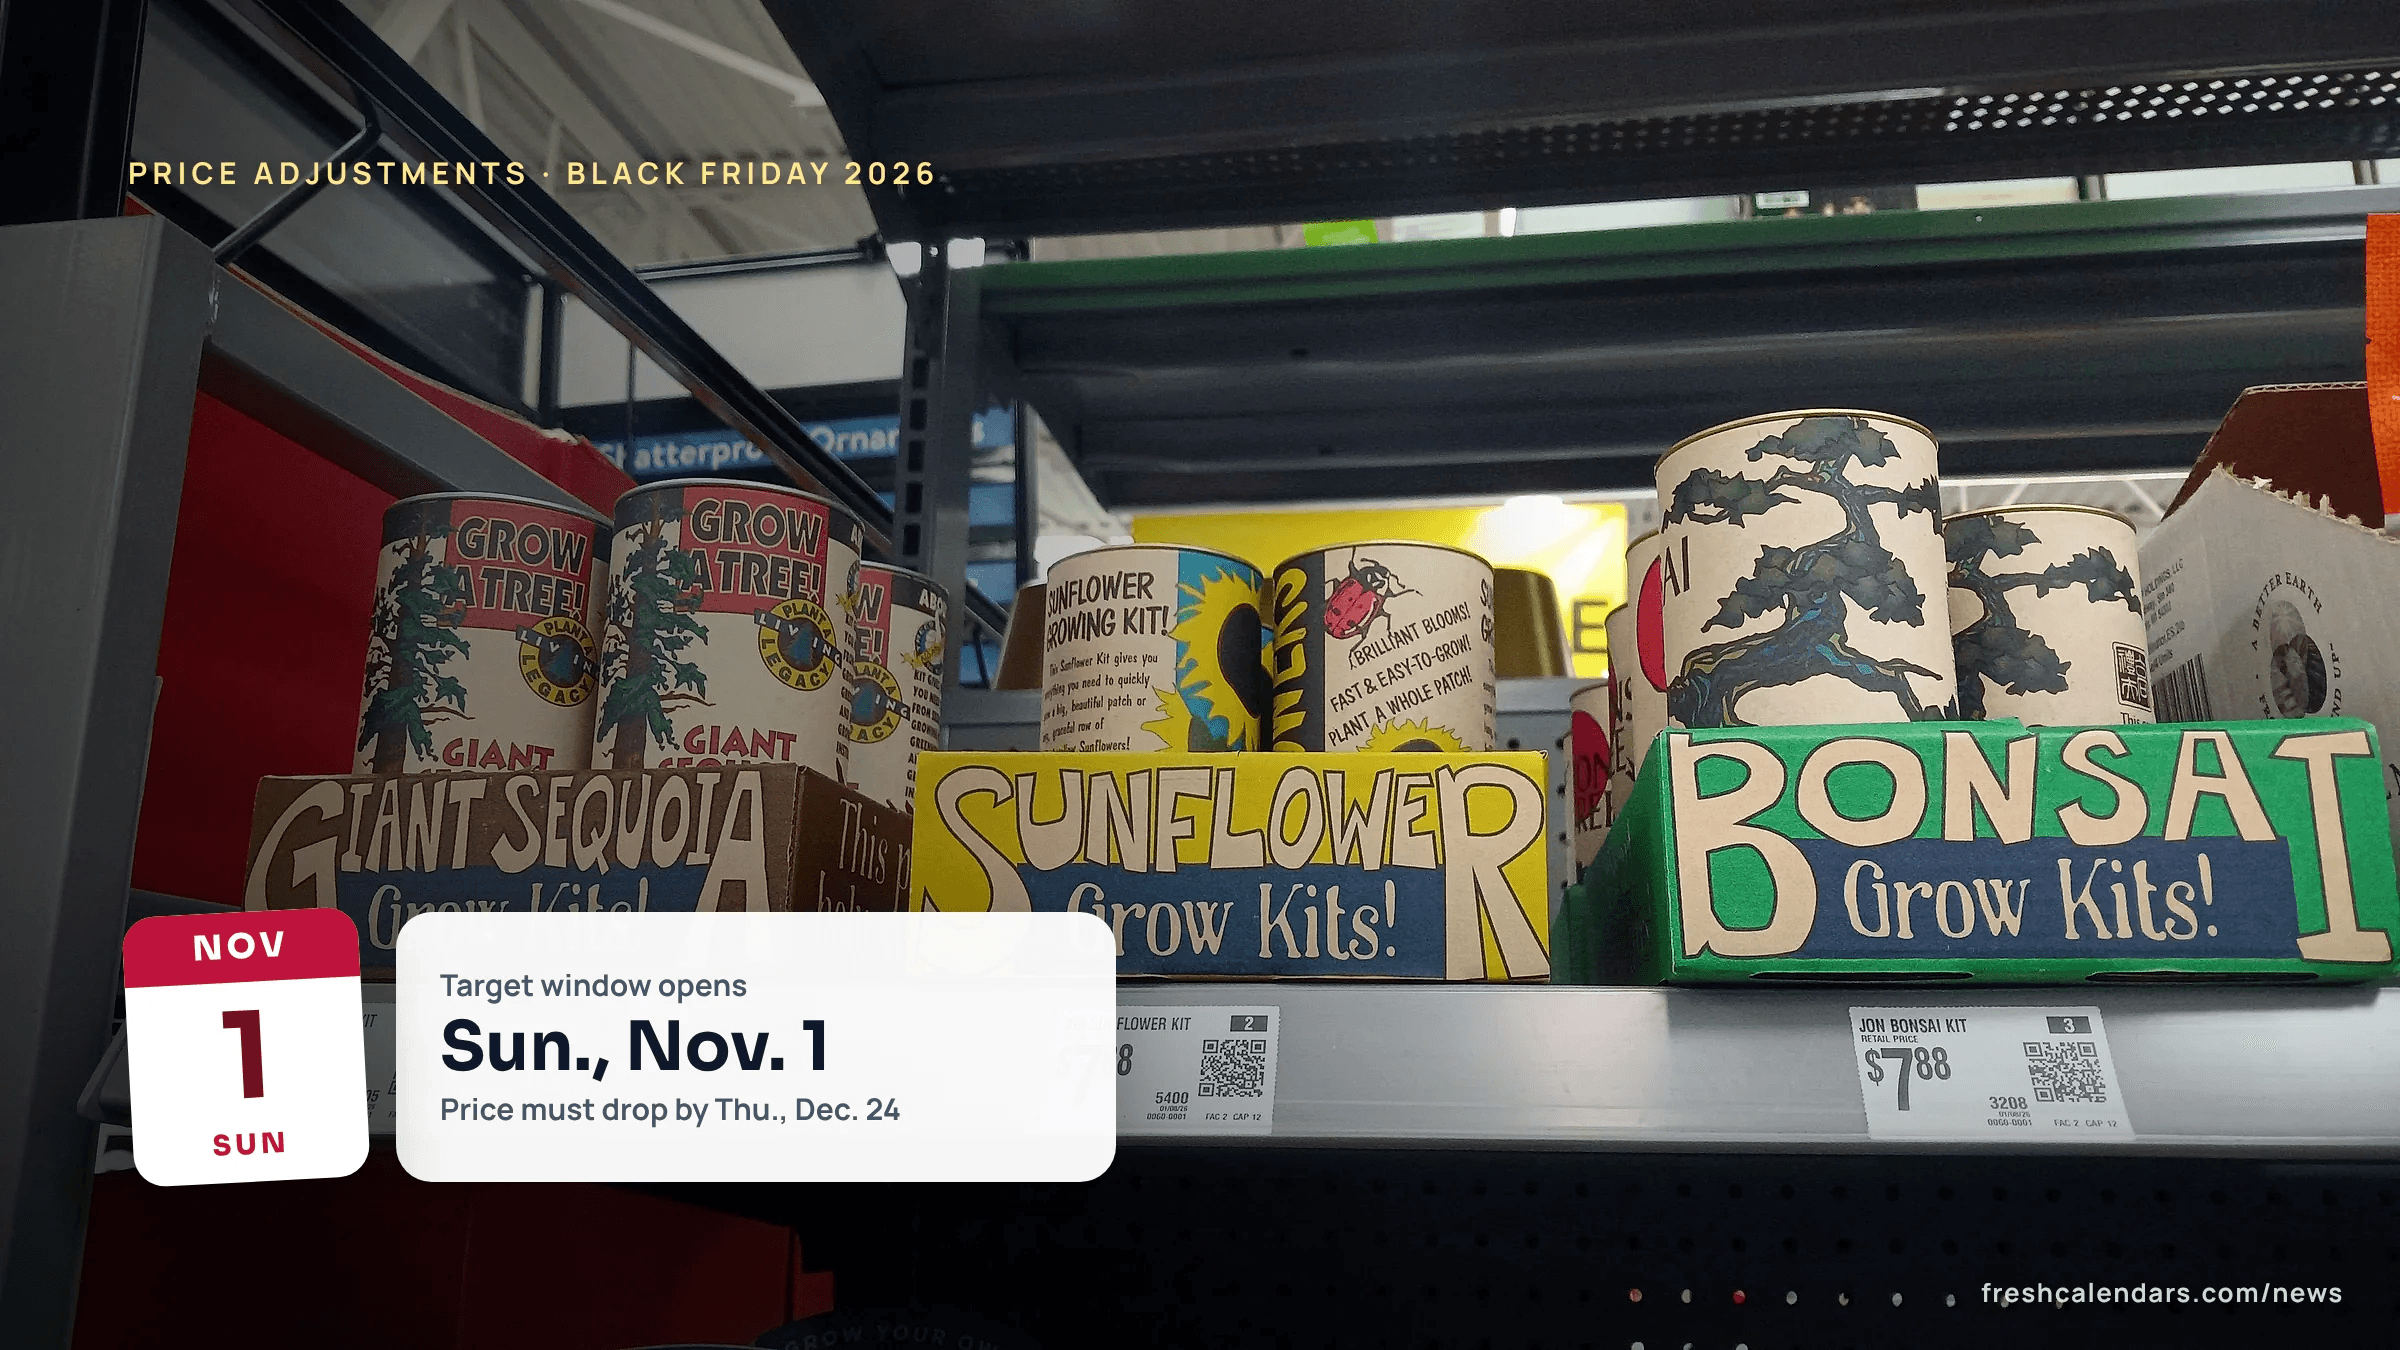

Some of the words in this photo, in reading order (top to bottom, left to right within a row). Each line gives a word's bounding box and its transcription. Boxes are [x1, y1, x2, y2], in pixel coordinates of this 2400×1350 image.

[456, 516, 588, 577] GROW
[690, 498, 822, 557] GROW
[445, 565, 477, 609] A
[478, 566, 586, 621] TREE!
[683, 549, 713, 593] A
[714, 549, 822, 603] TREE!
[1048, 571, 1155, 618] SUNFLOWER
[782, 602, 826, 625] PLANT
[2252, 572, 2283, 632] BETTER
[2285, 571, 2323, 614] EARTH
[544, 620, 588, 641] PLANT
[760, 613, 842, 663] LIVING
[1046, 608, 1117, 652] GROWING
[1123, 606, 1169, 637] KIT!
[1354, 622, 1421, 666] BRILLIANT
[1422, 602, 1471, 635] BLOOMS!
[520, 630, 592, 673] LIVIN
[762, 638, 829, 688] LEGACY
[1060, 656, 1093, 672] Sunflower
[1097, 652, 1110, 665] Kit
[1114, 652, 1138, 668] gives
[1142, 653, 1158, 667] you
[522, 655, 590, 704] LEGACY
[913, 685, 928, 700] YOU
[1068, 681, 1079, 696] you
[1082, 674, 1101, 689] need
[1105, 674, 1114, 686] to
[1118, 672, 1150, 689] quickly
[1330, 682, 1363, 713] FAST
[1364, 678, 1378, 695] &
[1377, 634, 1472, 688] EASY-TO-GROW!
[1071, 695, 1103, 712] beautiful
[1107, 694, 1132, 711] patch
[1136, 697, 1146, 706] or
[1077, 722, 1091, 732] row
[1094, 717, 1104, 730] of
[1328, 711, 1370, 746] PLANT
[1375, 705, 1387, 724] A
[1386, 684, 1433, 715] WHOLE
[1434, 665, 1473, 695] PATCH!
[442, 738, 555, 771] GIANT
[683, 725, 797, 762] GIANT
[1079, 737, 1130, 752] Sunflowers!
[246, 776, 486, 912] GIANT
[490, 768, 787, 912] SEQUOIA
[839, 798, 888, 884] This
[1668, 729, 2394, 963] BONSAI
[918, 764, 1552, 981] SUNFLOWER
[1843, 858, 2031, 942] Grow
[2056, 852, 2219, 942] Kits!
[1259, 879, 1397, 961] Kits!
[1116, 1017, 1167, 1031] FLOWER
[1171, 1017, 1192, 1030] KIT
[1244, 1016, 1255, 1031] 2
[1859, 1018, 1885, 1033] JON
[1891, 1018, 1941, 1033] BONSAI
[1946, 1018, 1967, 1033] KIT
[1861, 1035, 1891, 1043] RETAIL
[1893, 1035, 1919, 1043] PRICE
[2063, 1018, 2076, 1033] 3
[1155, 1091, 1189, 1104] 5400
[1205, 1113, 1221, 1121] FAC
[1232, 1113, 1250, 1121] CAP
[1252, 1113, 1262, 1121] 12
[1989, 1096, 2028, 1110] 3208
[2053, 1119, 2072, 1128] FAC
[2085, 1120, 2104, 1128] CAP
